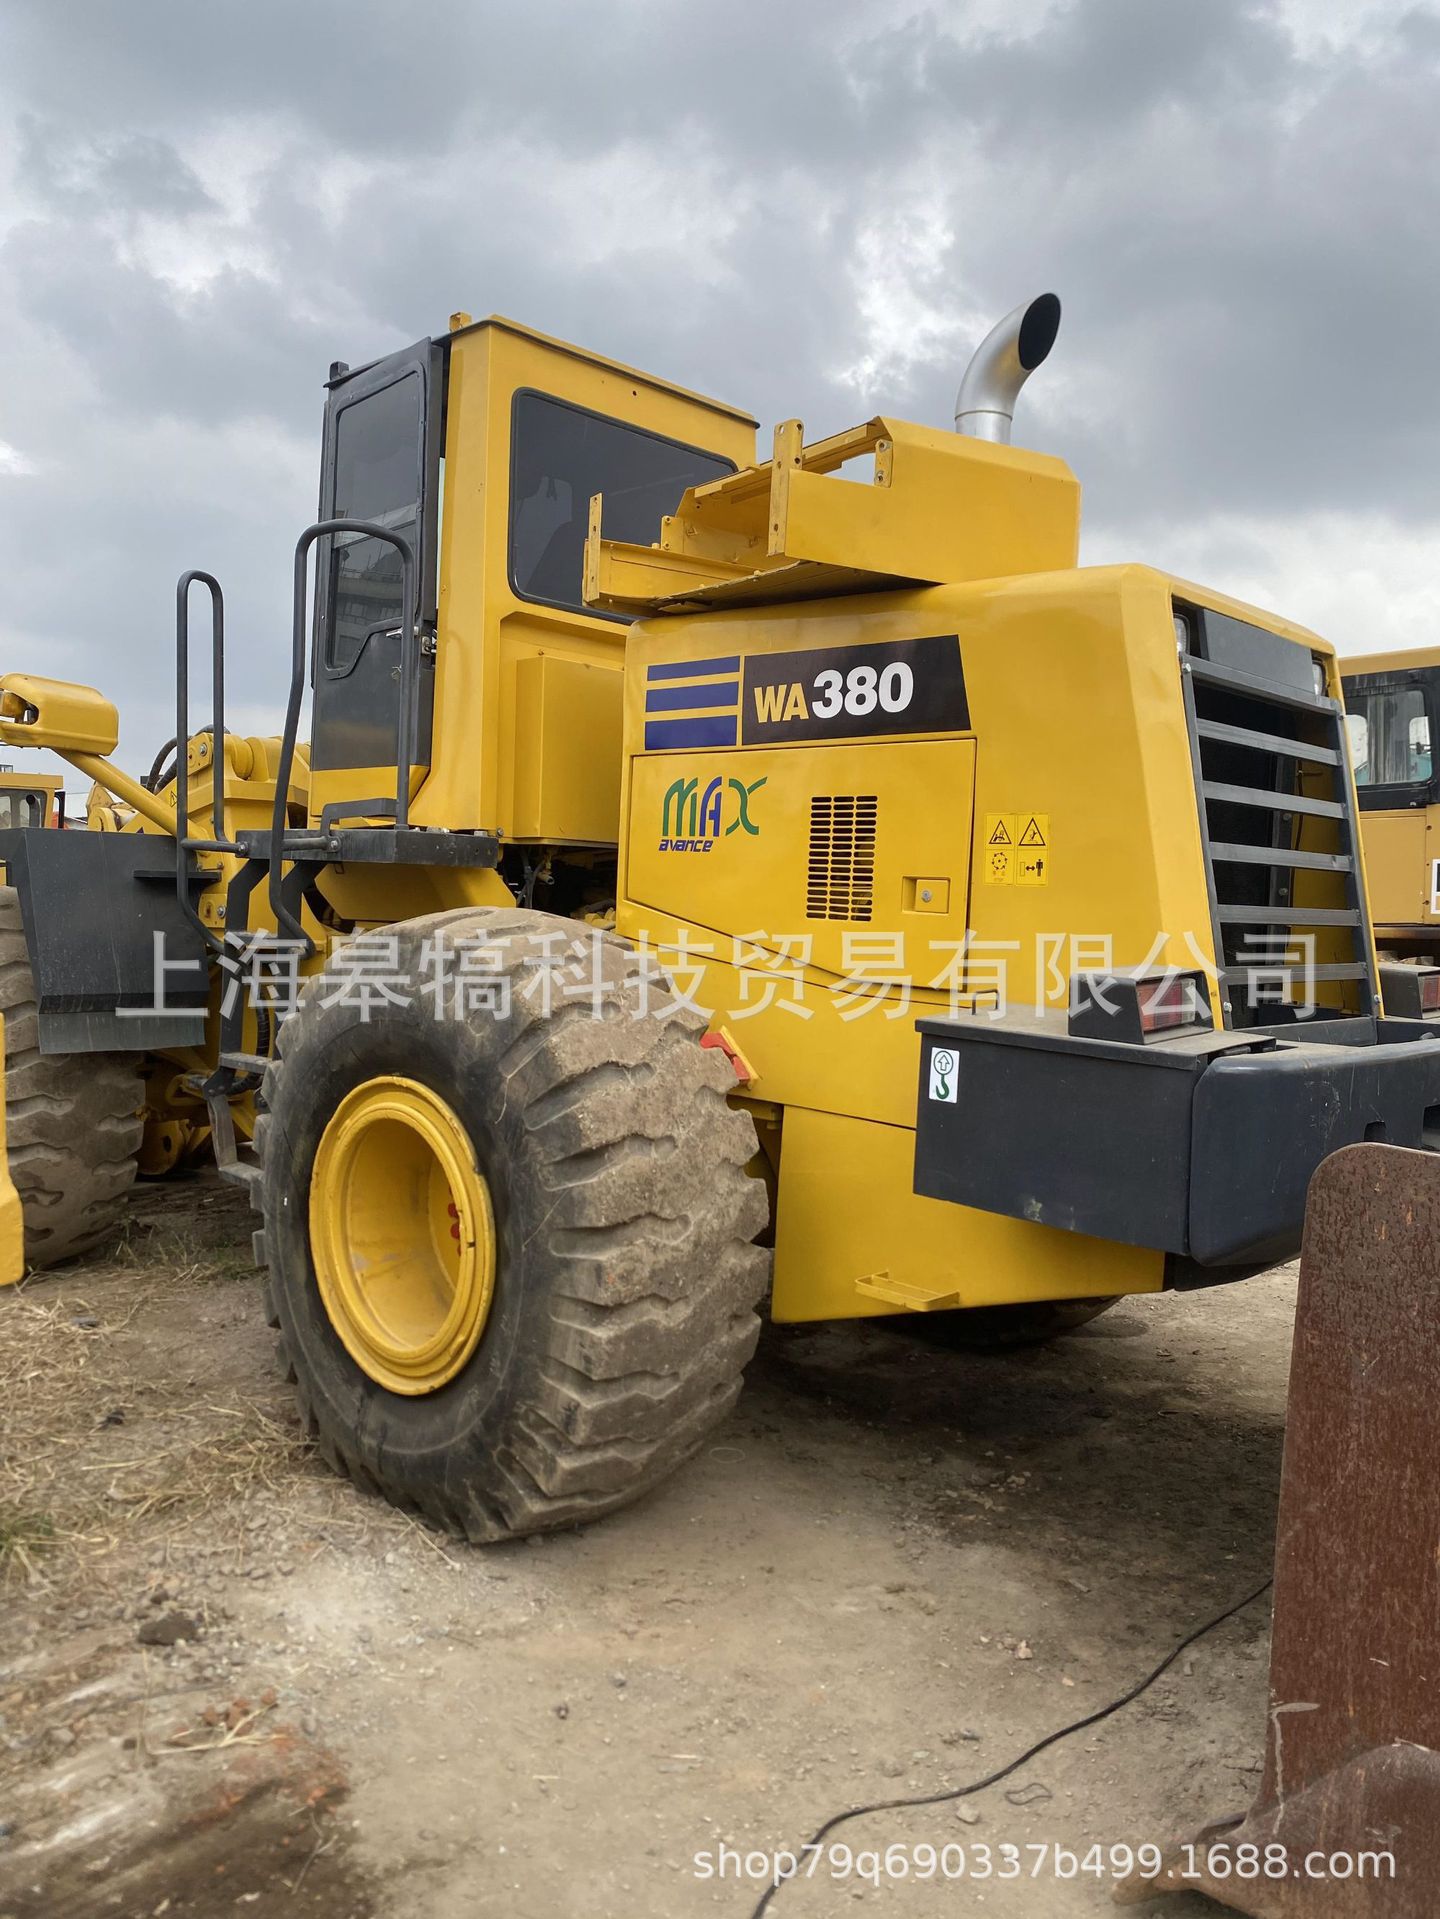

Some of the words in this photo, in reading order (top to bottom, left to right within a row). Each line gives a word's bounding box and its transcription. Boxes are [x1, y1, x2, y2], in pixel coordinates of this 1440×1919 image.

[754, 661, 914, 724] WA380
[662, 776, 768, 837] MAX
[658, 839, 714, 853] avance
